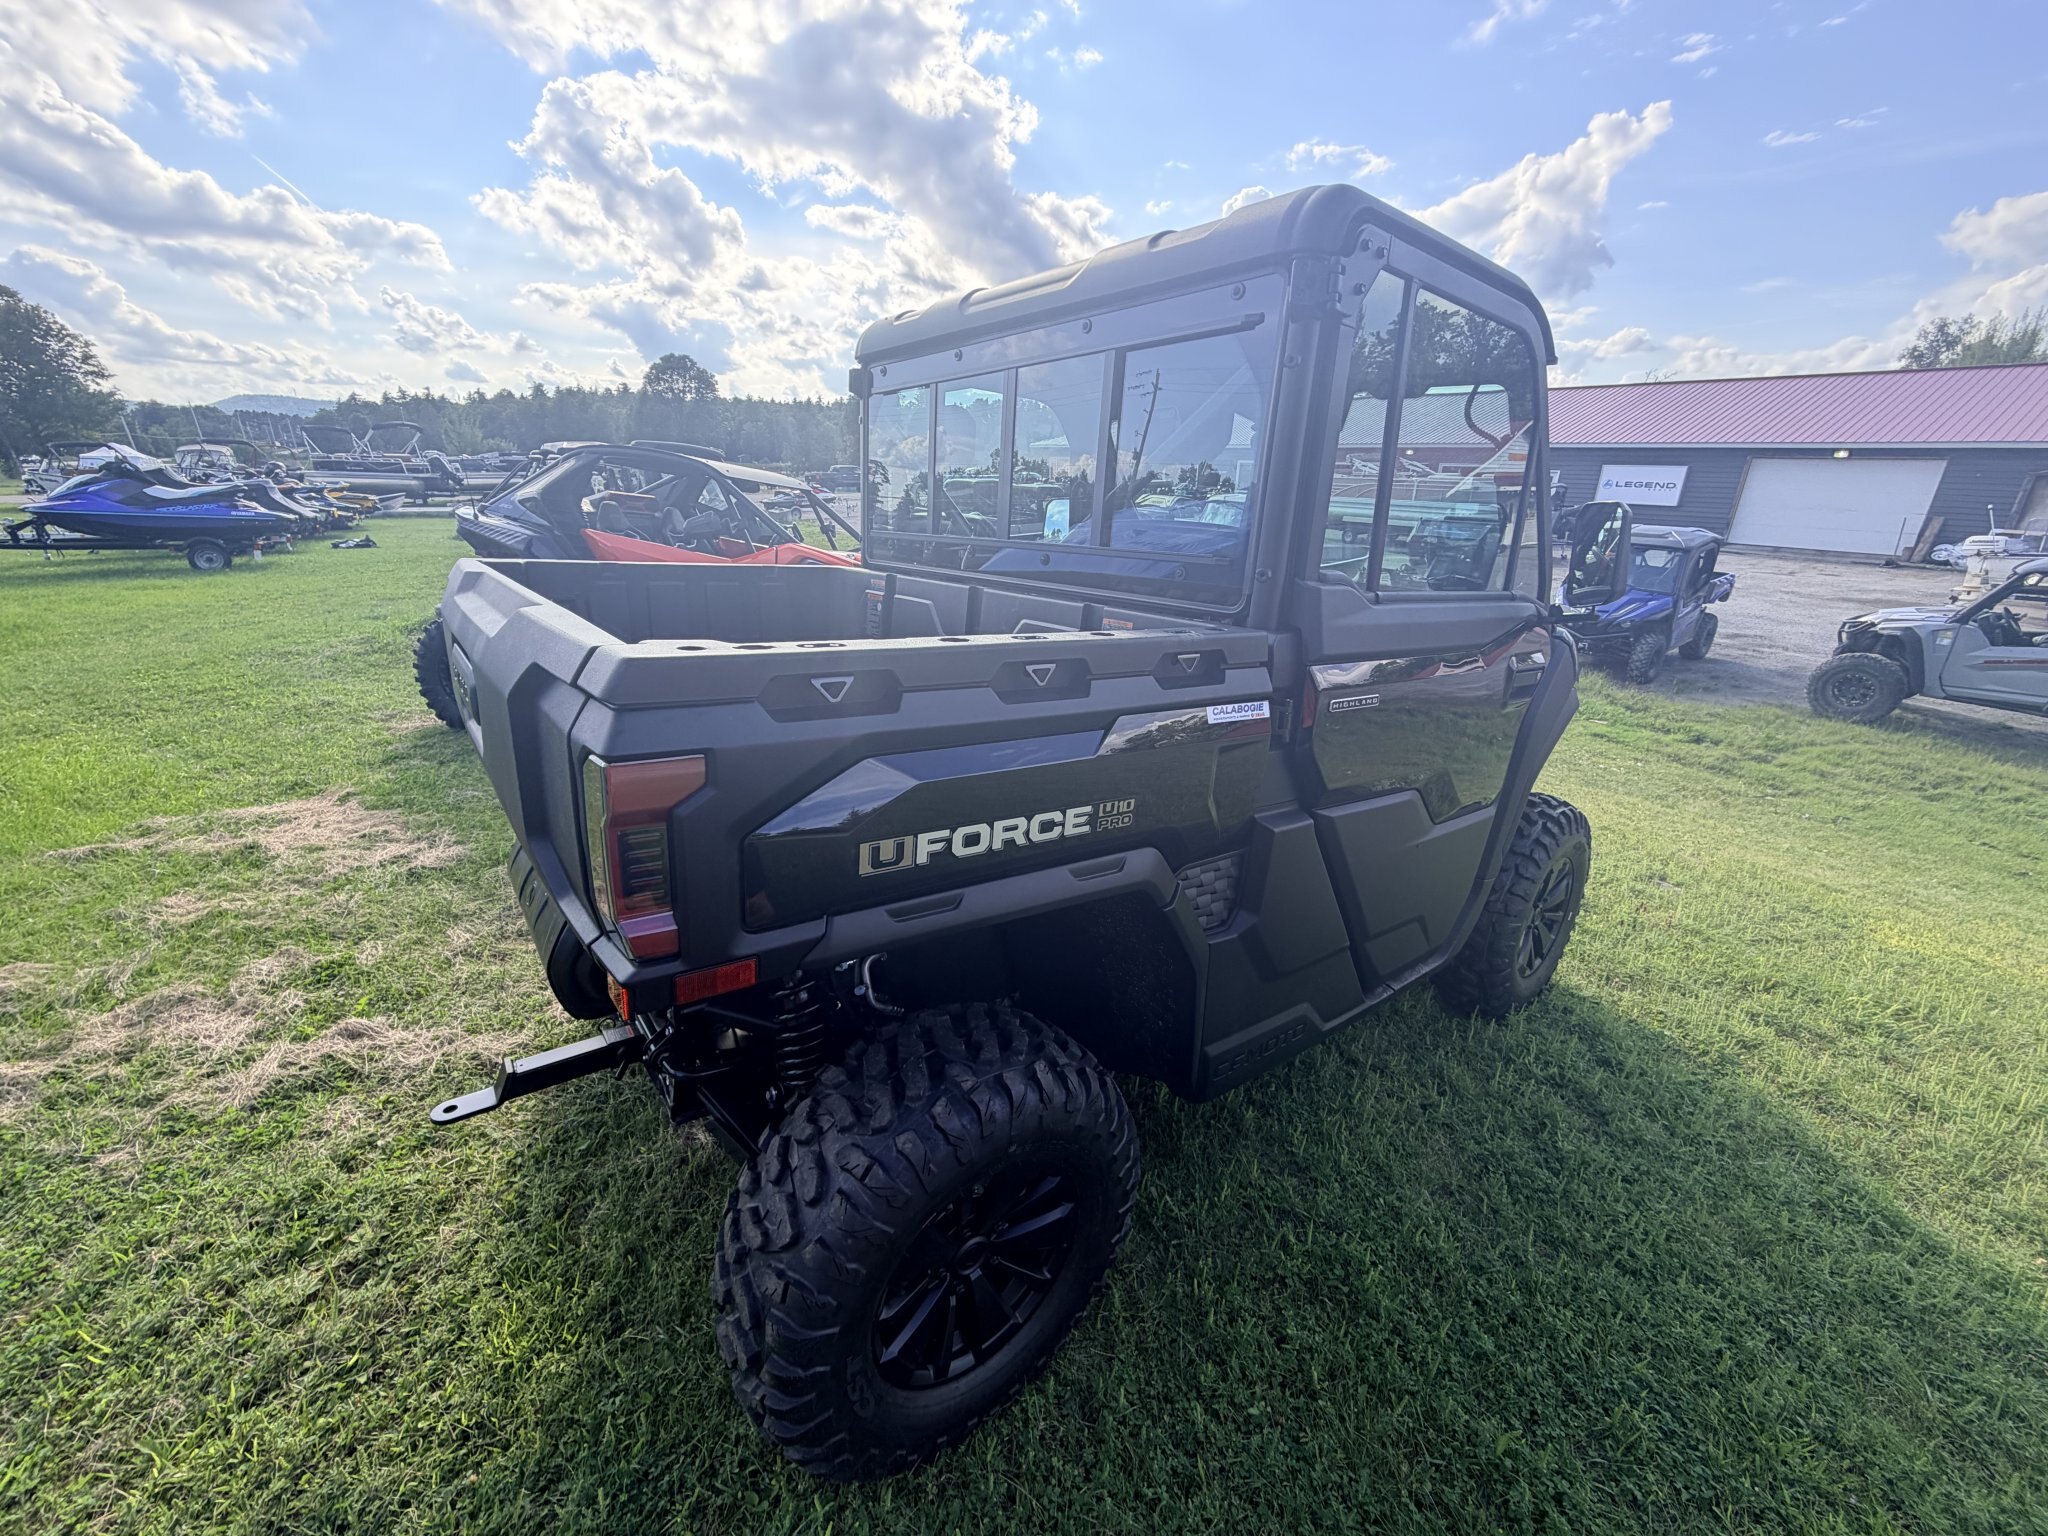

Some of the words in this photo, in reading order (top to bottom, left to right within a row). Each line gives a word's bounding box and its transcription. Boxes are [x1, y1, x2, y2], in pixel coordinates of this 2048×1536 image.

[1212, 702, 1264, 716] CALABOGIE
[1333, 697, 1378, 709] HIGHLAND
[1099, 799, 1135, 817] U10
[1097, 814, 1133, 831] PRO
